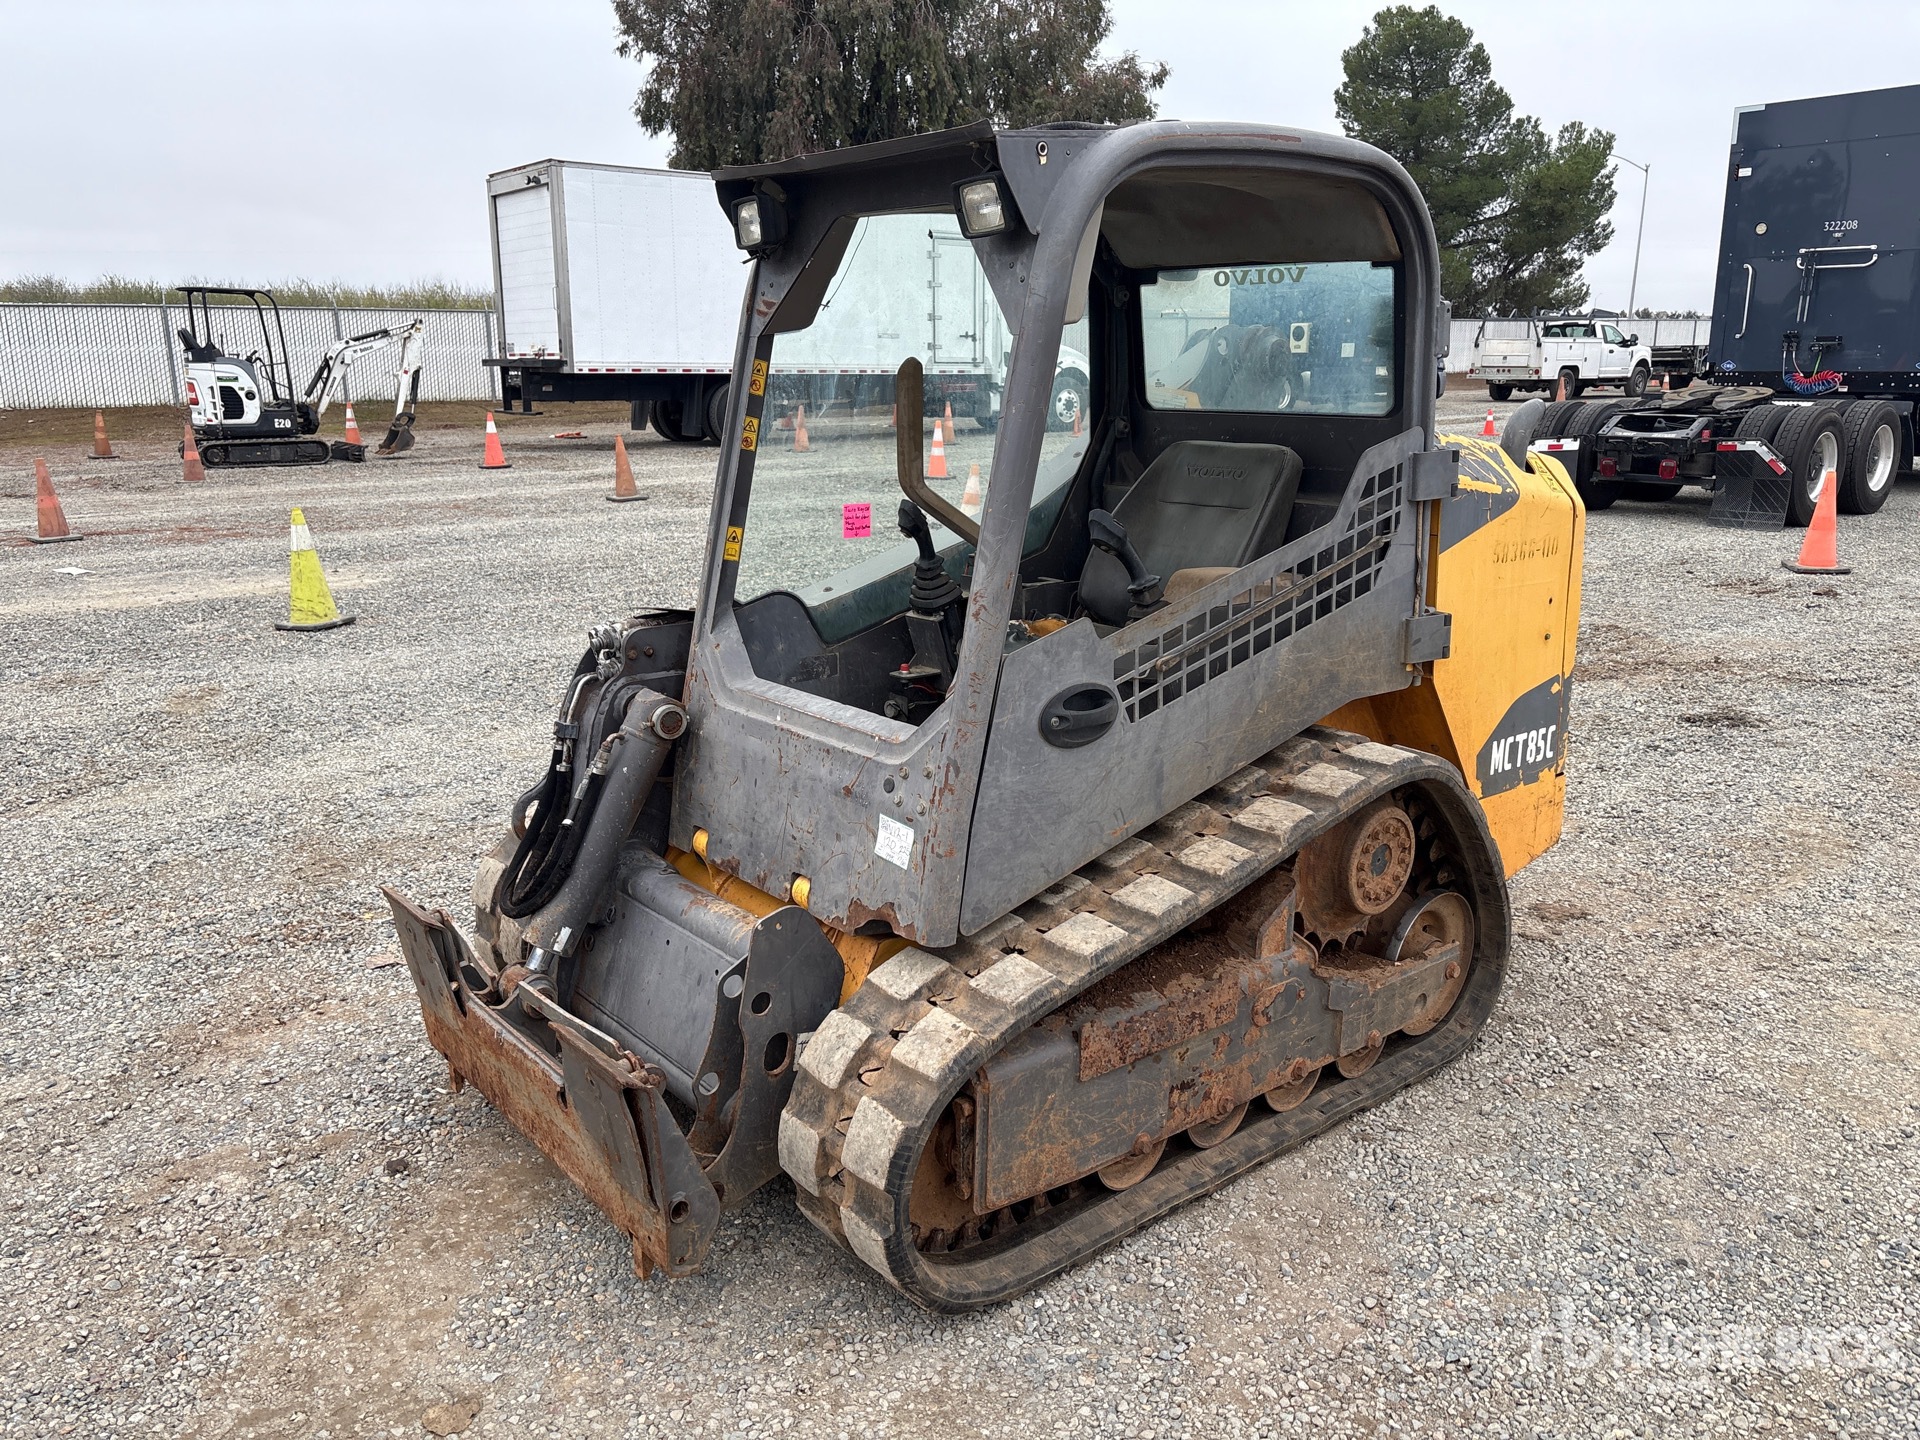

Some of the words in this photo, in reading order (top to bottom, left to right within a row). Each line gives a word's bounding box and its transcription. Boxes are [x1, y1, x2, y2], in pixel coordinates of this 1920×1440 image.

[1823, 219, 1859, 231] 322208
[274, 419, 291, 428] E20
[1186, 464, 1248, 480] VOLVO
[1490, 724, 1556, 775] MCT85C
